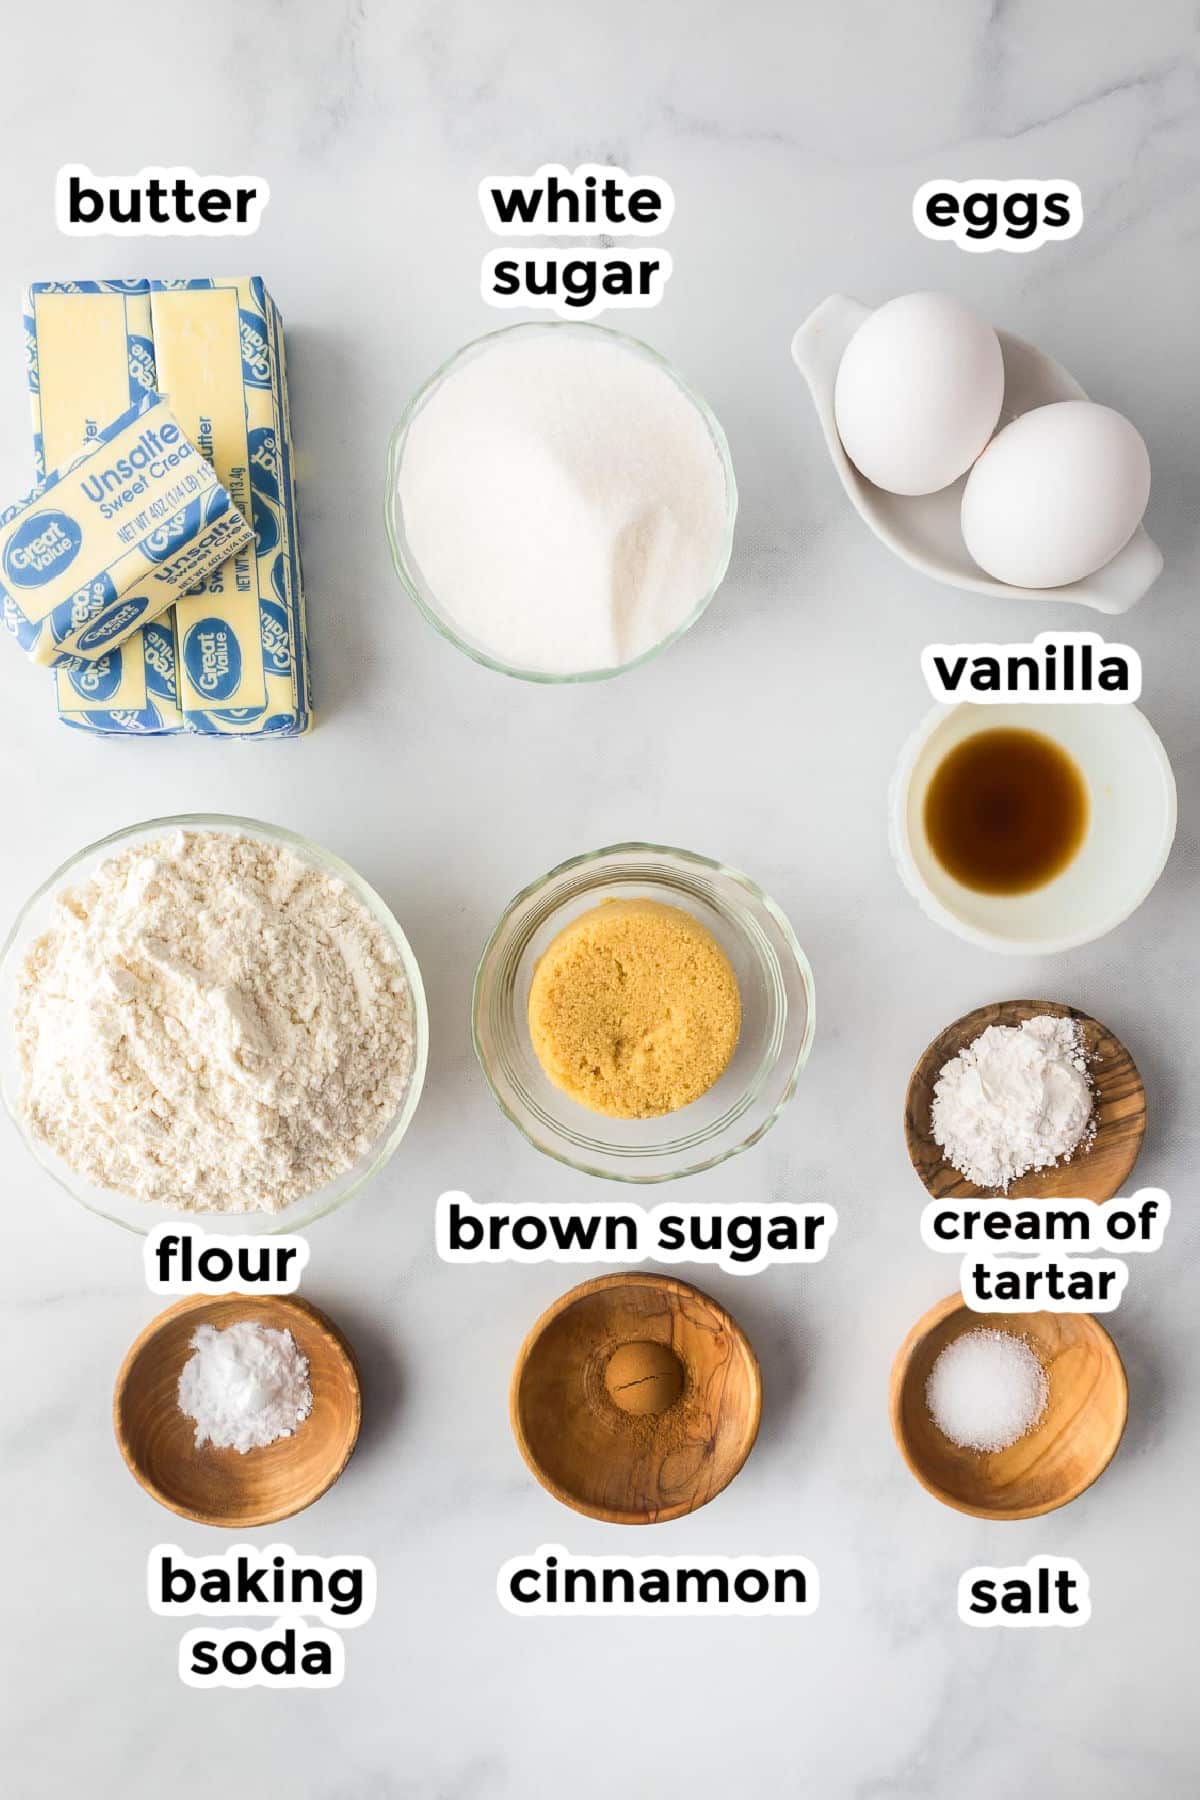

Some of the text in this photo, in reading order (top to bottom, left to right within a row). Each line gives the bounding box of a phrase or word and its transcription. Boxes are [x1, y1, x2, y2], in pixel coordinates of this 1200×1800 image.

[99, 442, 195, 520] Sweet Crea
[10, 522, 66, 569] Great
[116, 521, 137, 544] NET
[134, 510, 151, 530] WT
[32, 538, 72, 571] Value
[236, 575, 250, 592] NET
[197, 632, 219, 690] Great
[215, 631, 229, 677] Value
